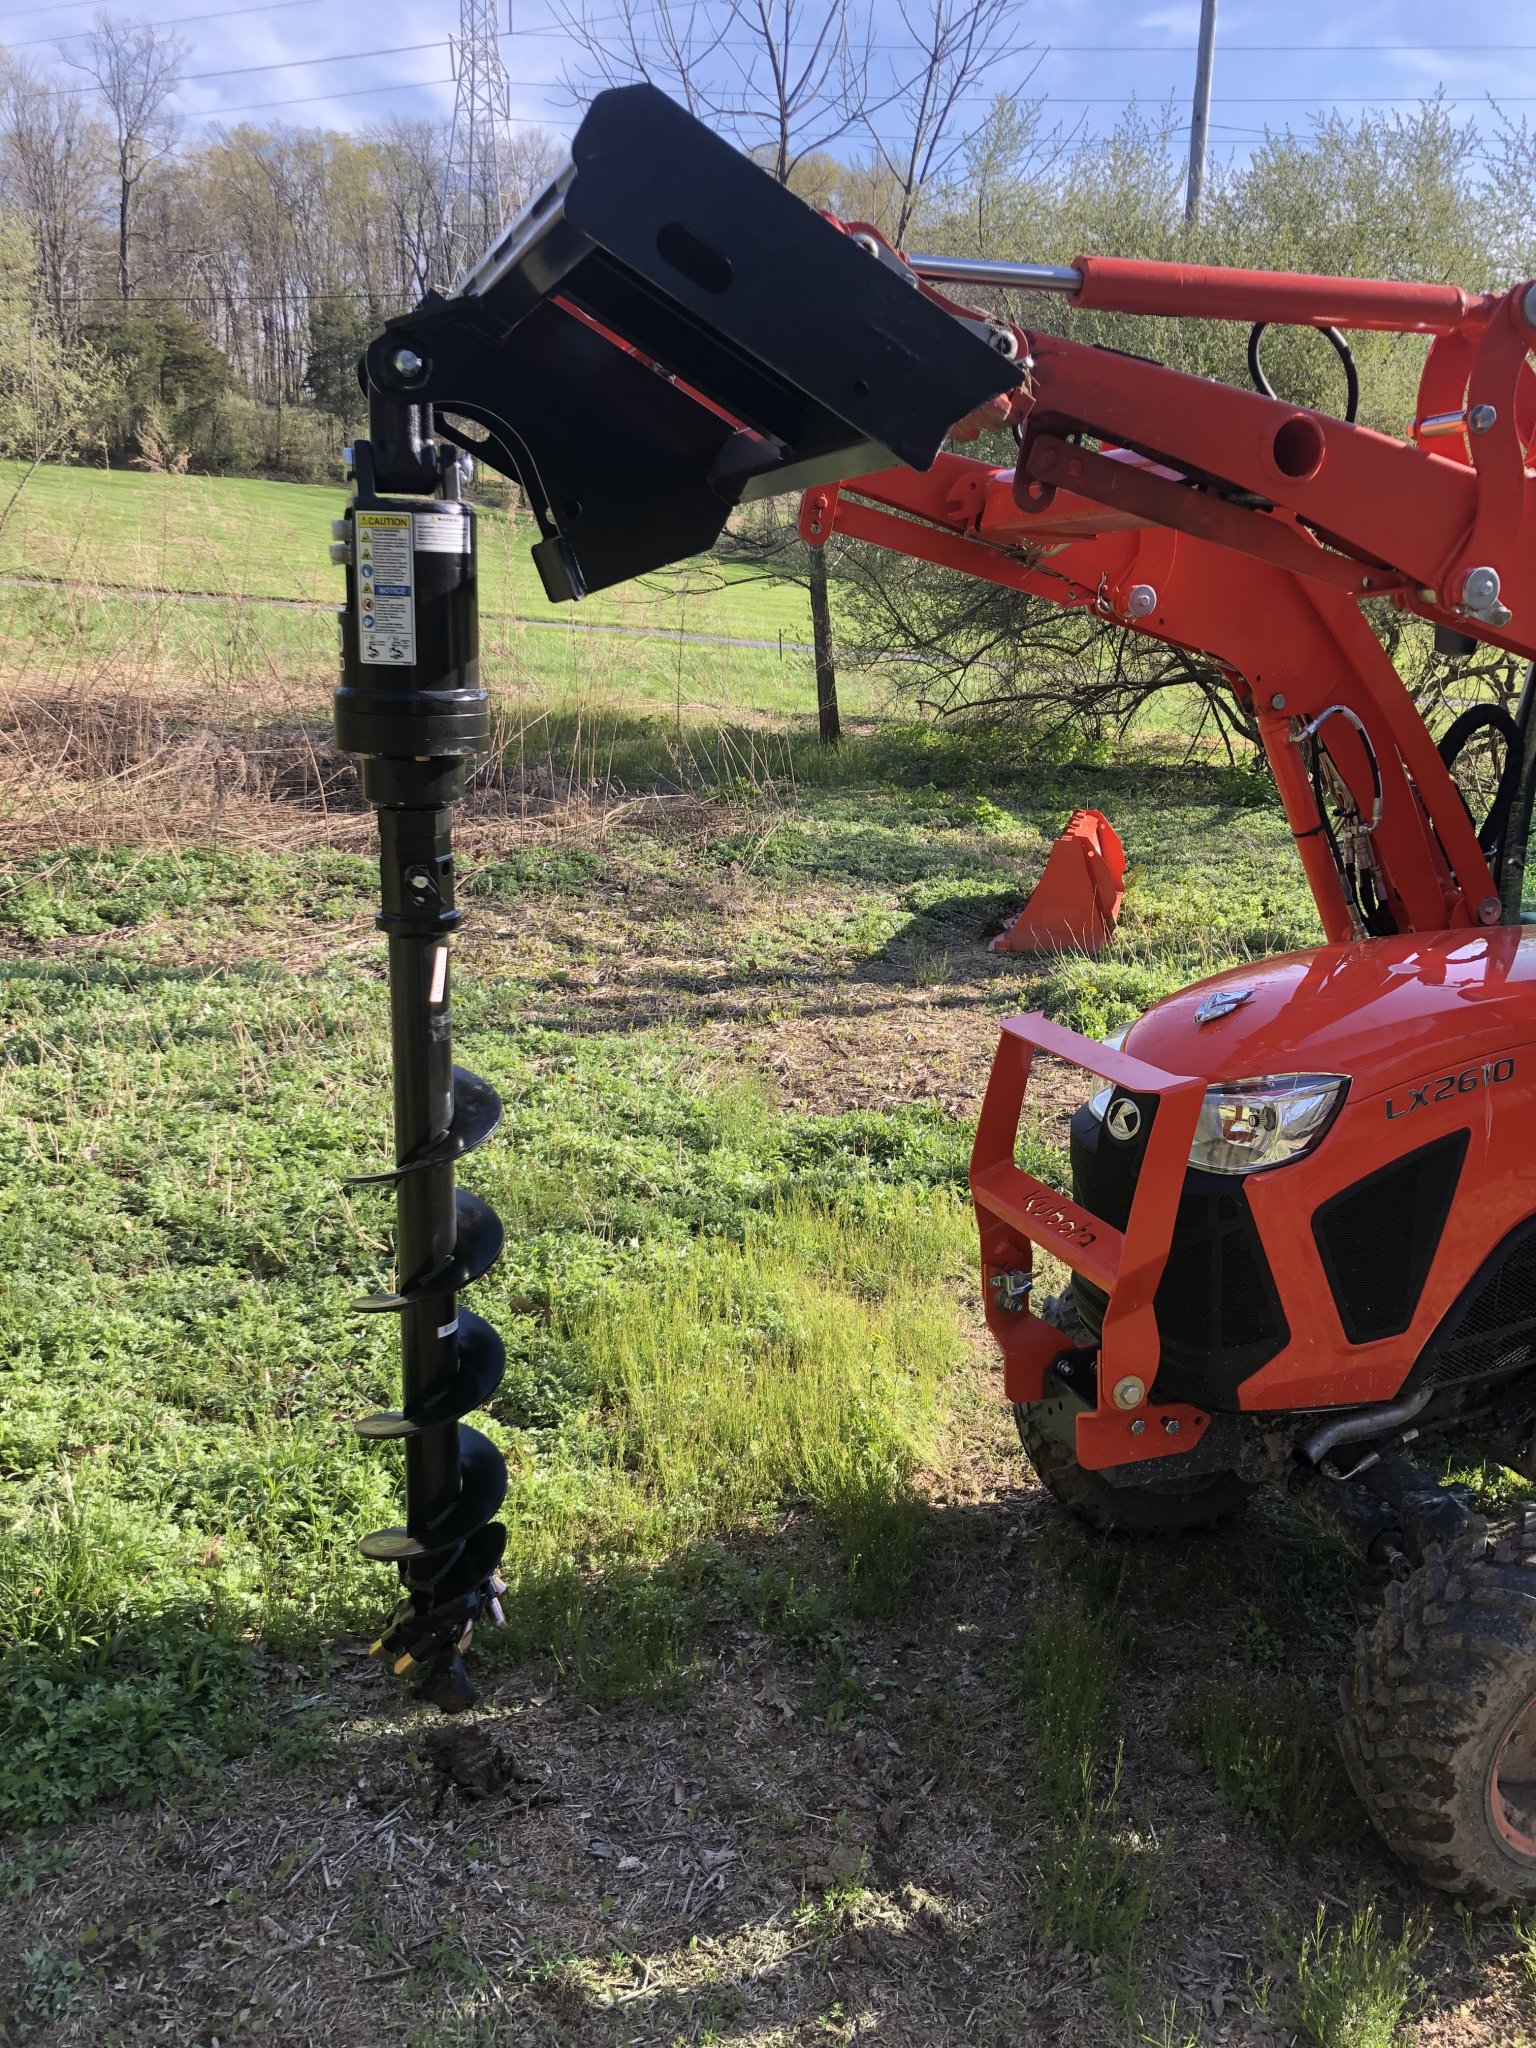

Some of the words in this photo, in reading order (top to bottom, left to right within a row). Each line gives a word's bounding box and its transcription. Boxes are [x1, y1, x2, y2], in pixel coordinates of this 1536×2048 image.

[368, 517, 407, 527] CAUTION
[379, 586, 407, 595] NOTICE
[1385, 1058, 1515, 1120] LX2610
